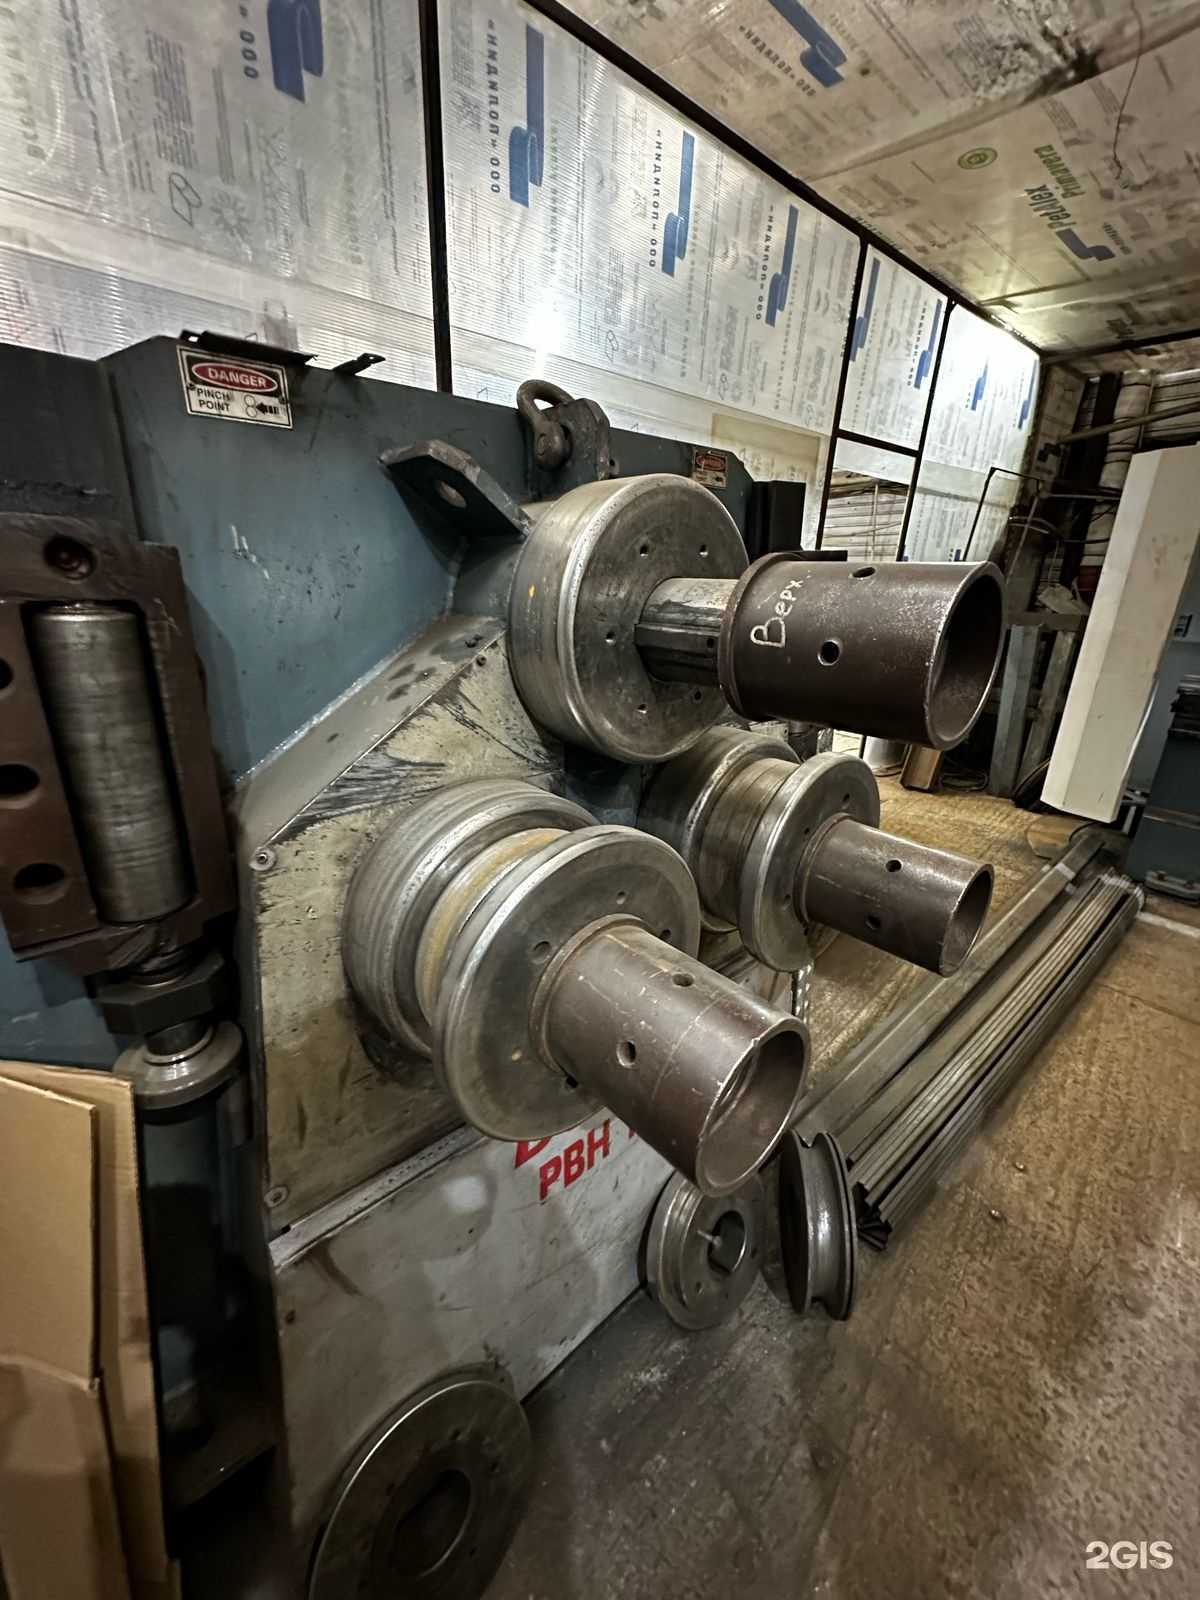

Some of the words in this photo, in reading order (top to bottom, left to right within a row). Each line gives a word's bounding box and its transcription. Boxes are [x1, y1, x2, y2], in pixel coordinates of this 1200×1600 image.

[207, 367, 267, 387] DANGER
[196, 387, 231, 401] PINCH
[198, 399, 231, 412] POINT
